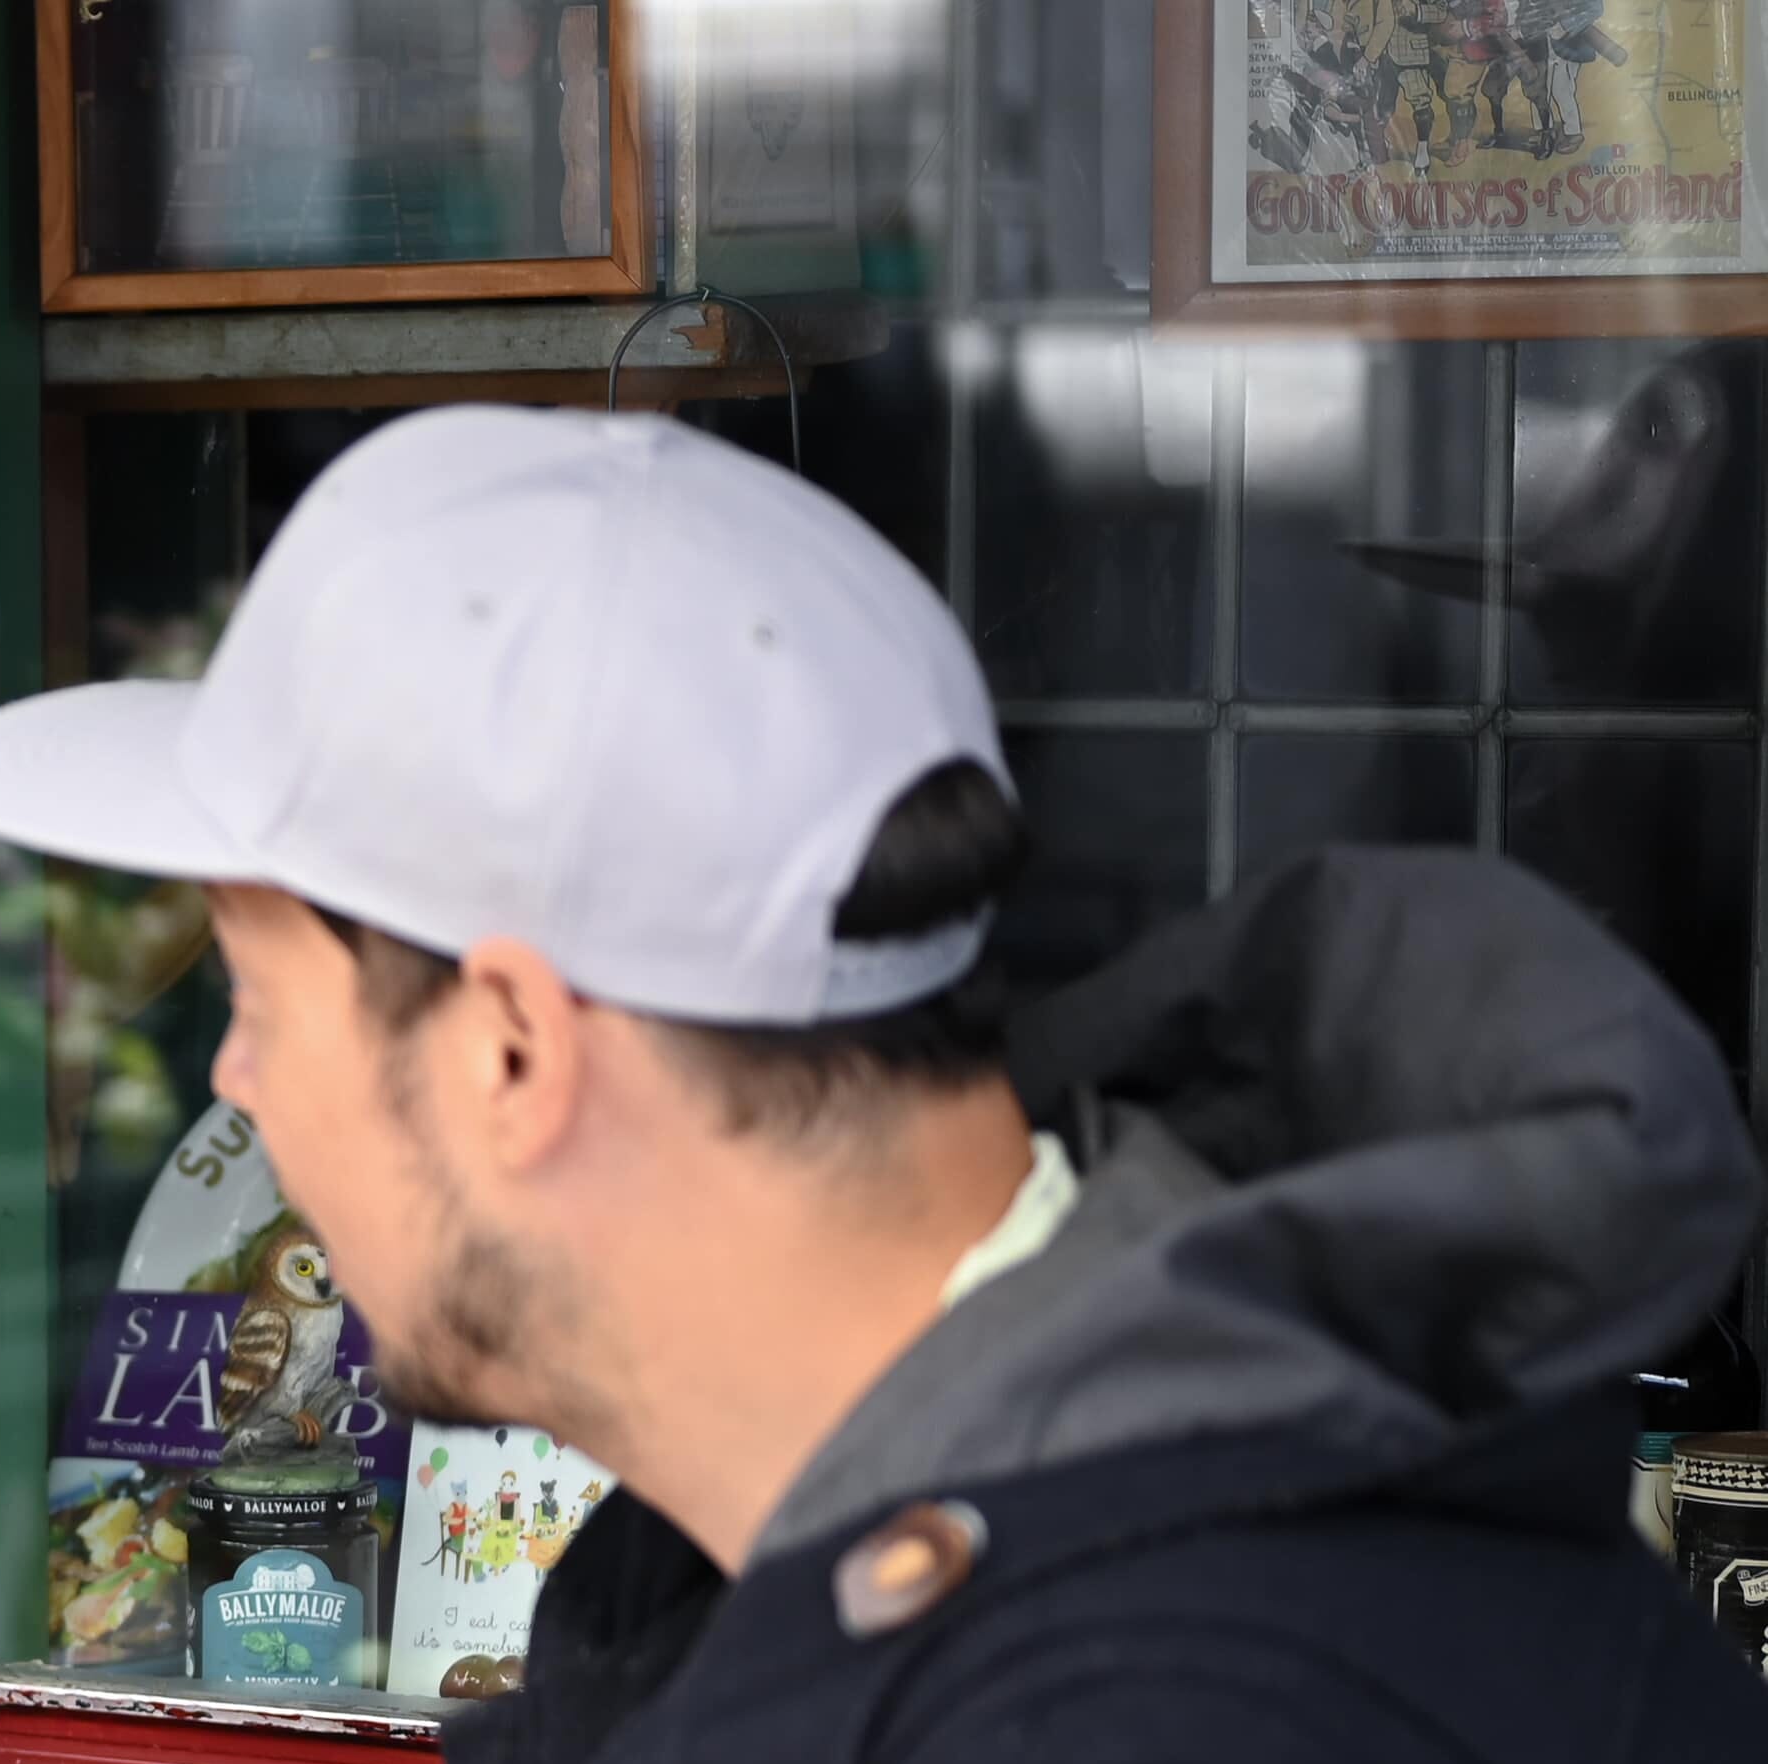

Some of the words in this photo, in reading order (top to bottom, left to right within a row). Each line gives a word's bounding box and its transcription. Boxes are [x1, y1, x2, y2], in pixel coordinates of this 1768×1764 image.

[1667, 88, 1741, 102] BELLINGHAM
[1594, 165, 1641, 176] SILLOTH
[96, 1353, 388, 1438] LAB
[244, 1500, 327, 1514] BALLYMALOE
[219, 1594, 346, 1622] BALLYMALOE
